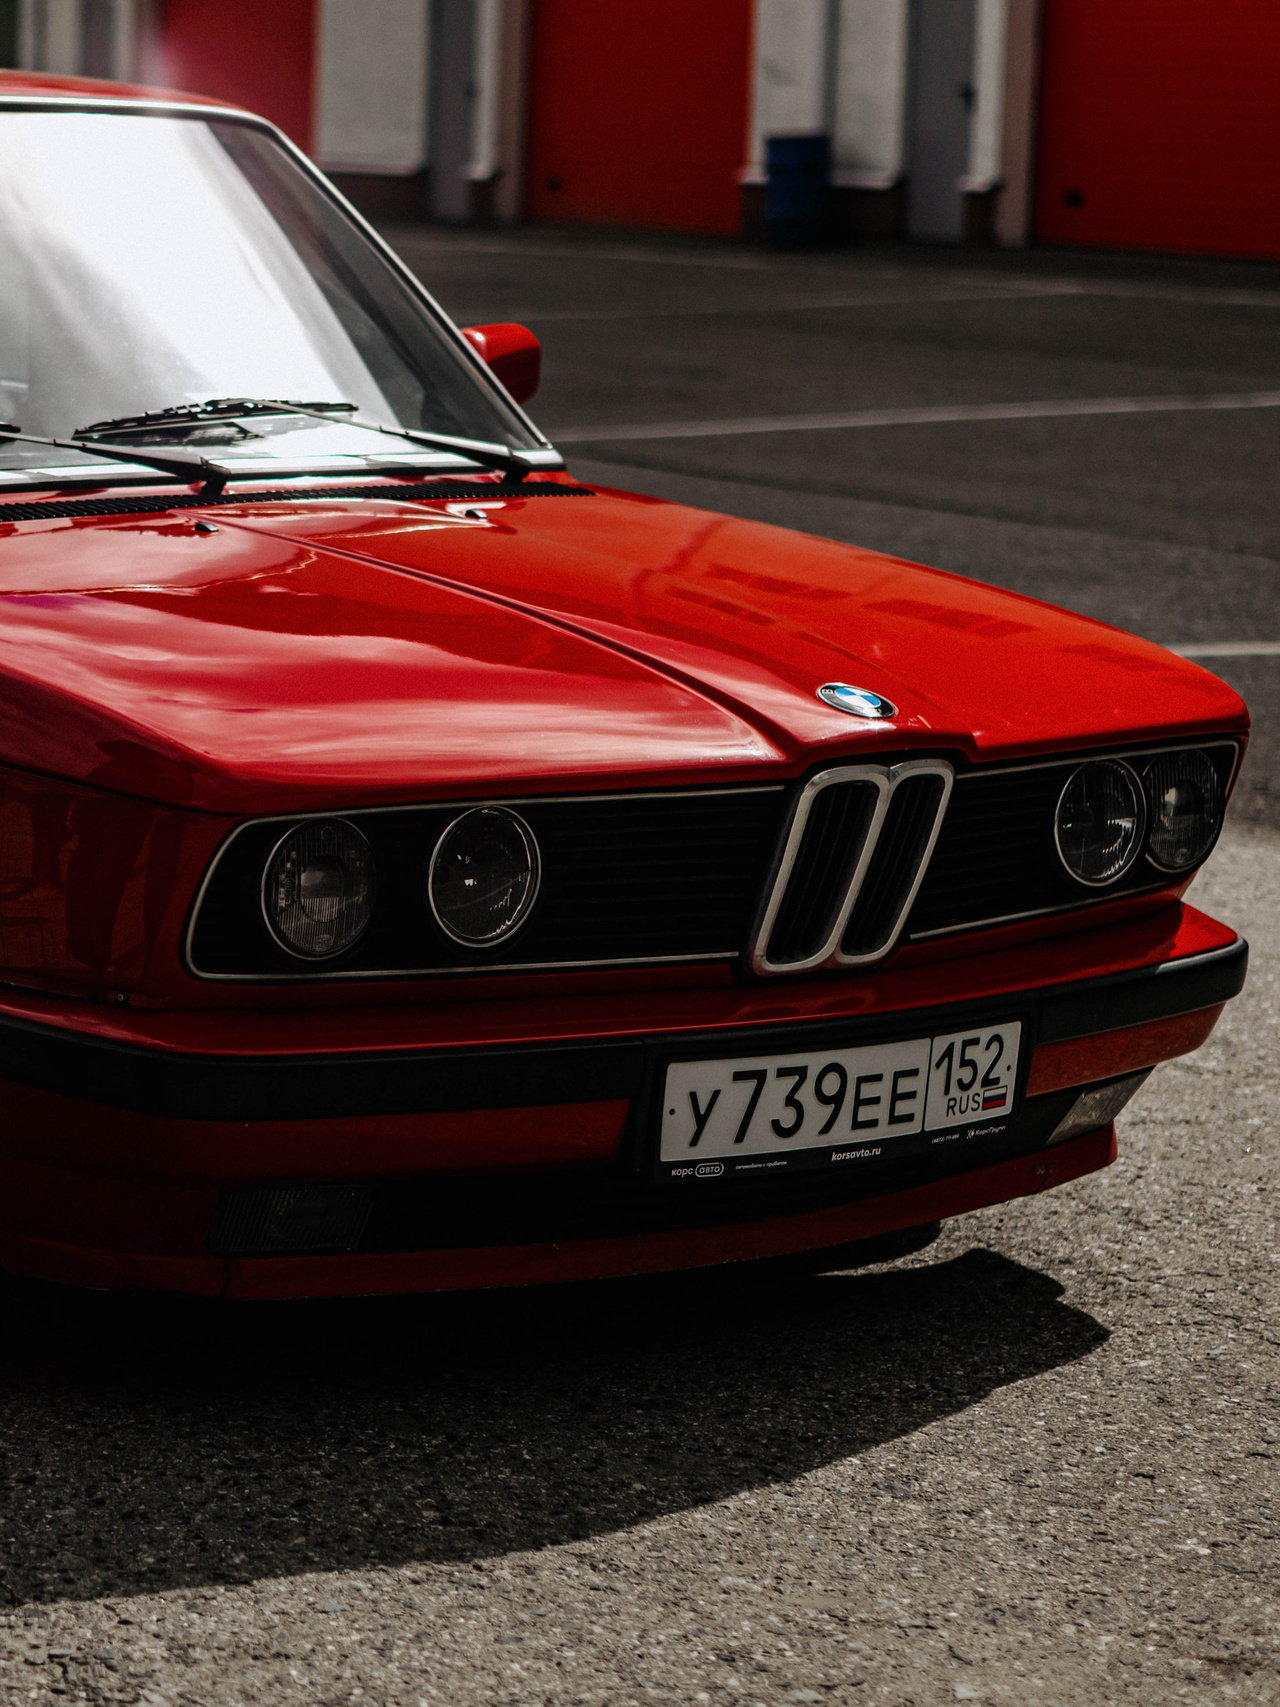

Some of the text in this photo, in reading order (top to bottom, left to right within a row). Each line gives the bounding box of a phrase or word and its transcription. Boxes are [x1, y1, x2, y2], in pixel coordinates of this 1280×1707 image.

[934, 1033, 1005, 1096] 152
[946, 1094, 981, 1118] RUS
[831, 1148, 881, 1161] korsavto.ru
[671, 1165, 720, 1178] корс авто
